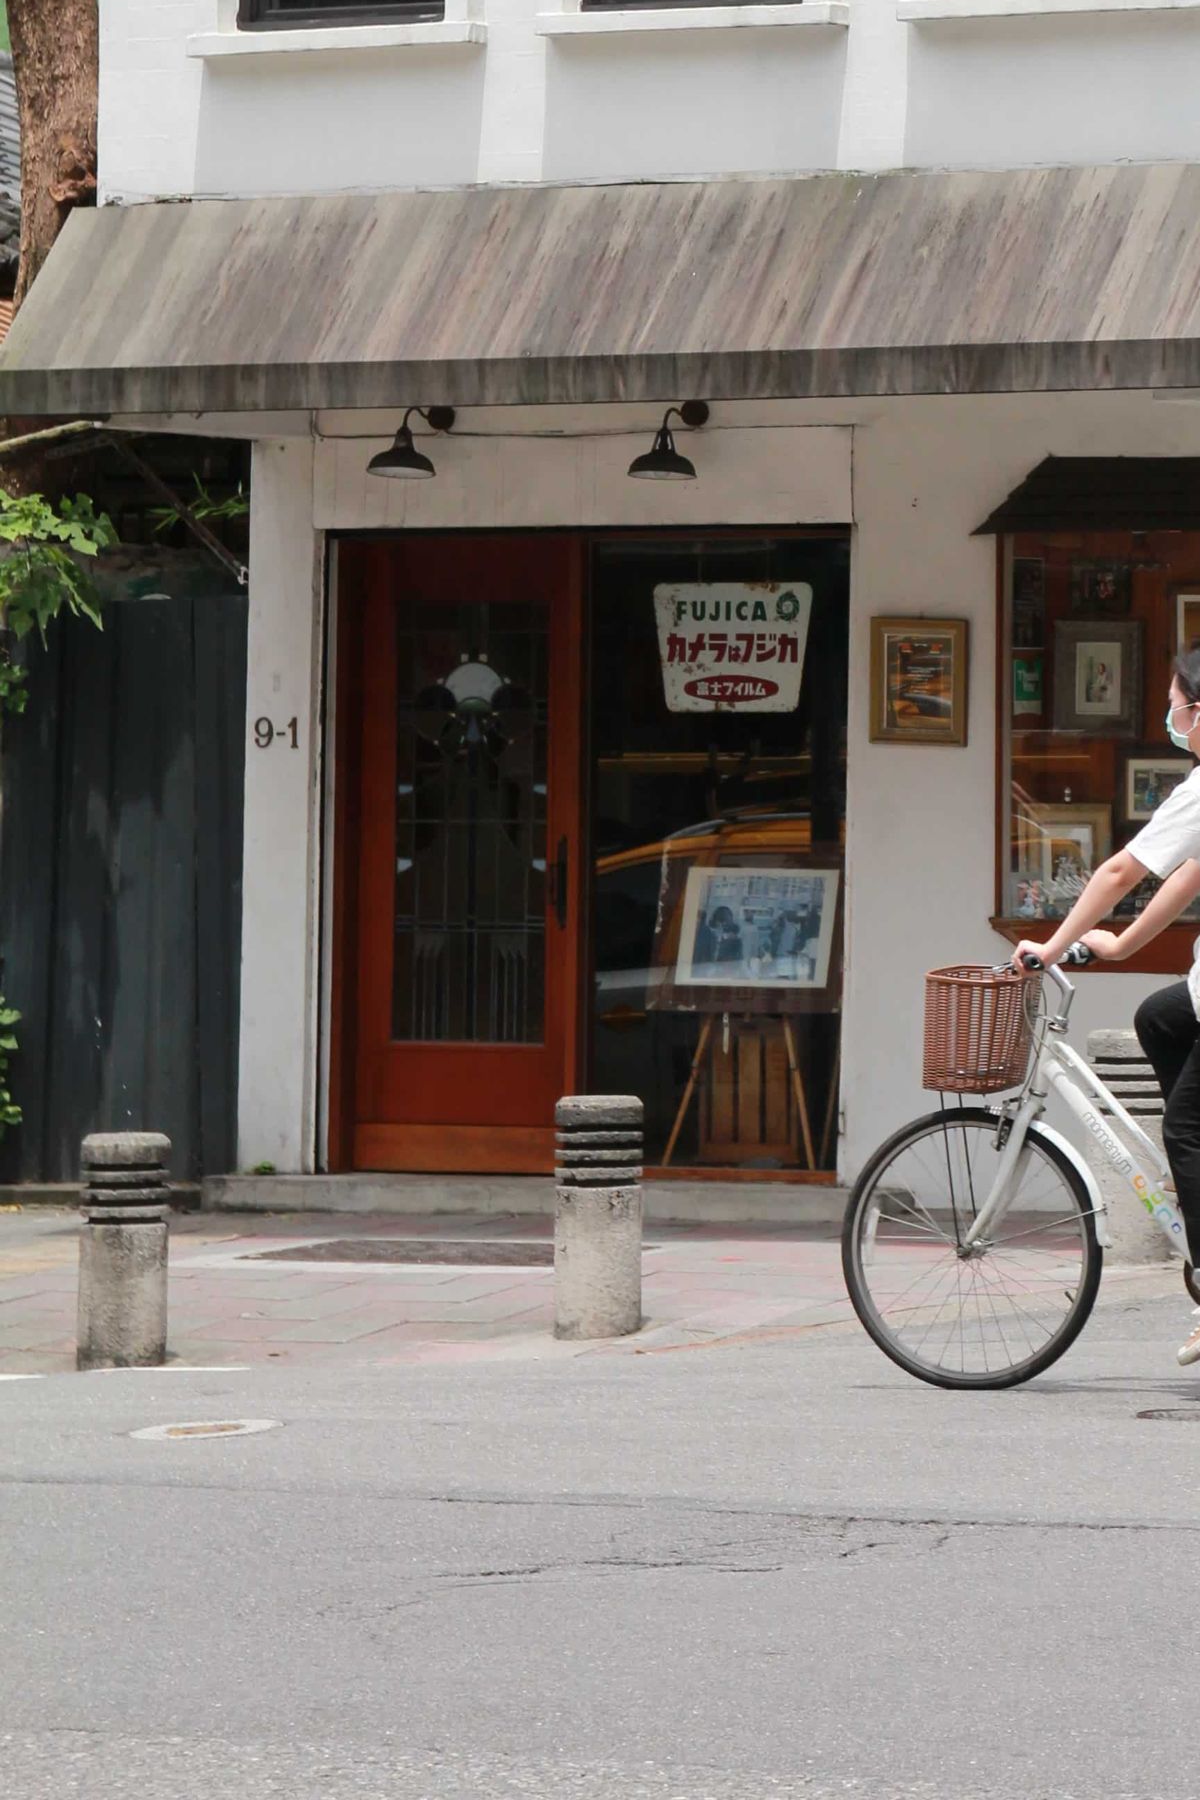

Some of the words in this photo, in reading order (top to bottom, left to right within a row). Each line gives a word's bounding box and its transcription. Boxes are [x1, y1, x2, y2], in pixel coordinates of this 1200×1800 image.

[675, 600, 768, 622] FUJICA
[666, 632, 799, 664] カメラはフジカ
[254, 716, 299, 749] 9-1
[1082, 1110, 1133, 1176] momentum
